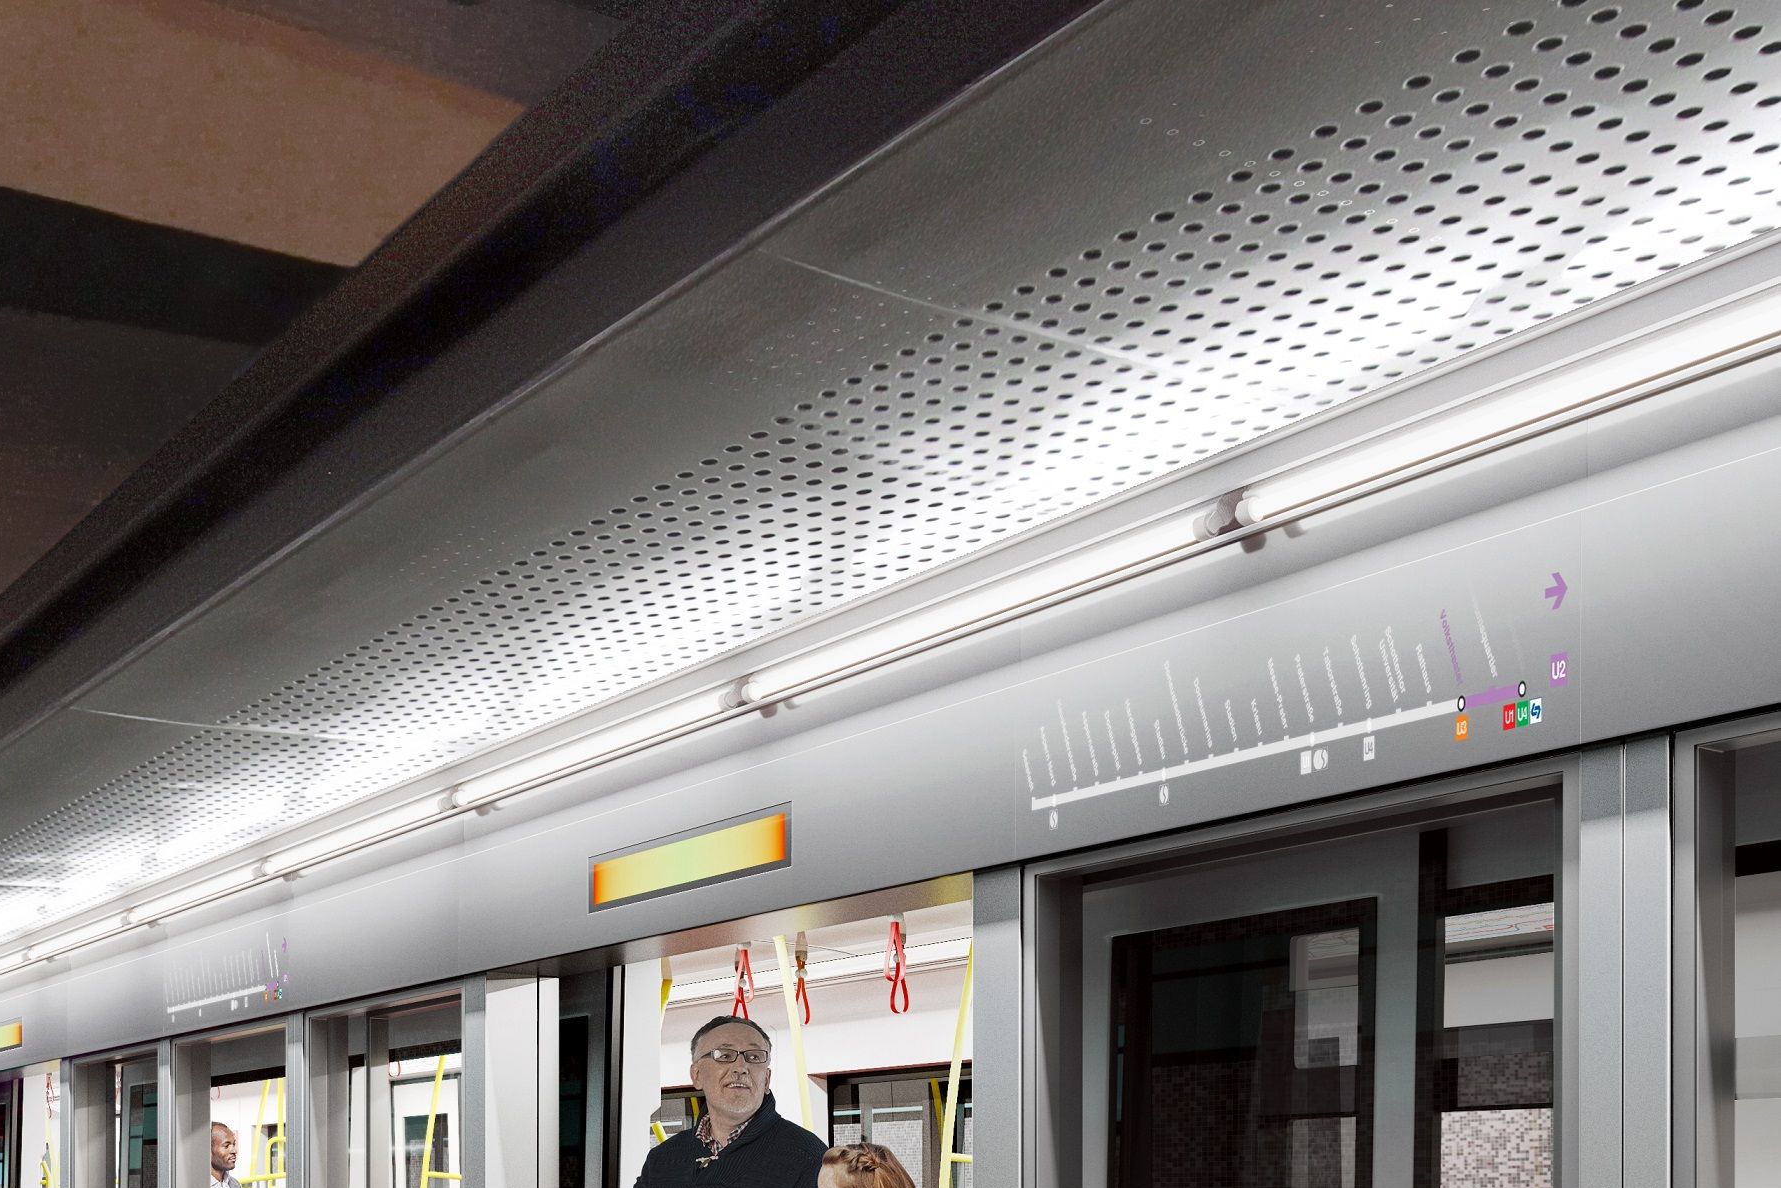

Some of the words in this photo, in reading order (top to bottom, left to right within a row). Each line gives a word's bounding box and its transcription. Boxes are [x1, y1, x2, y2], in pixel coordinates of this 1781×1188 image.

[1415, 643, 1433, 694] Rathaus
[1551, 660, 1567, 680] U2
[1224, 698, 1238, 743] Stadion
[1504, 709, 1515, 725] U1
[1517, 706, 1528, 722] U4
[1456, 720, 1468, 736] U3
